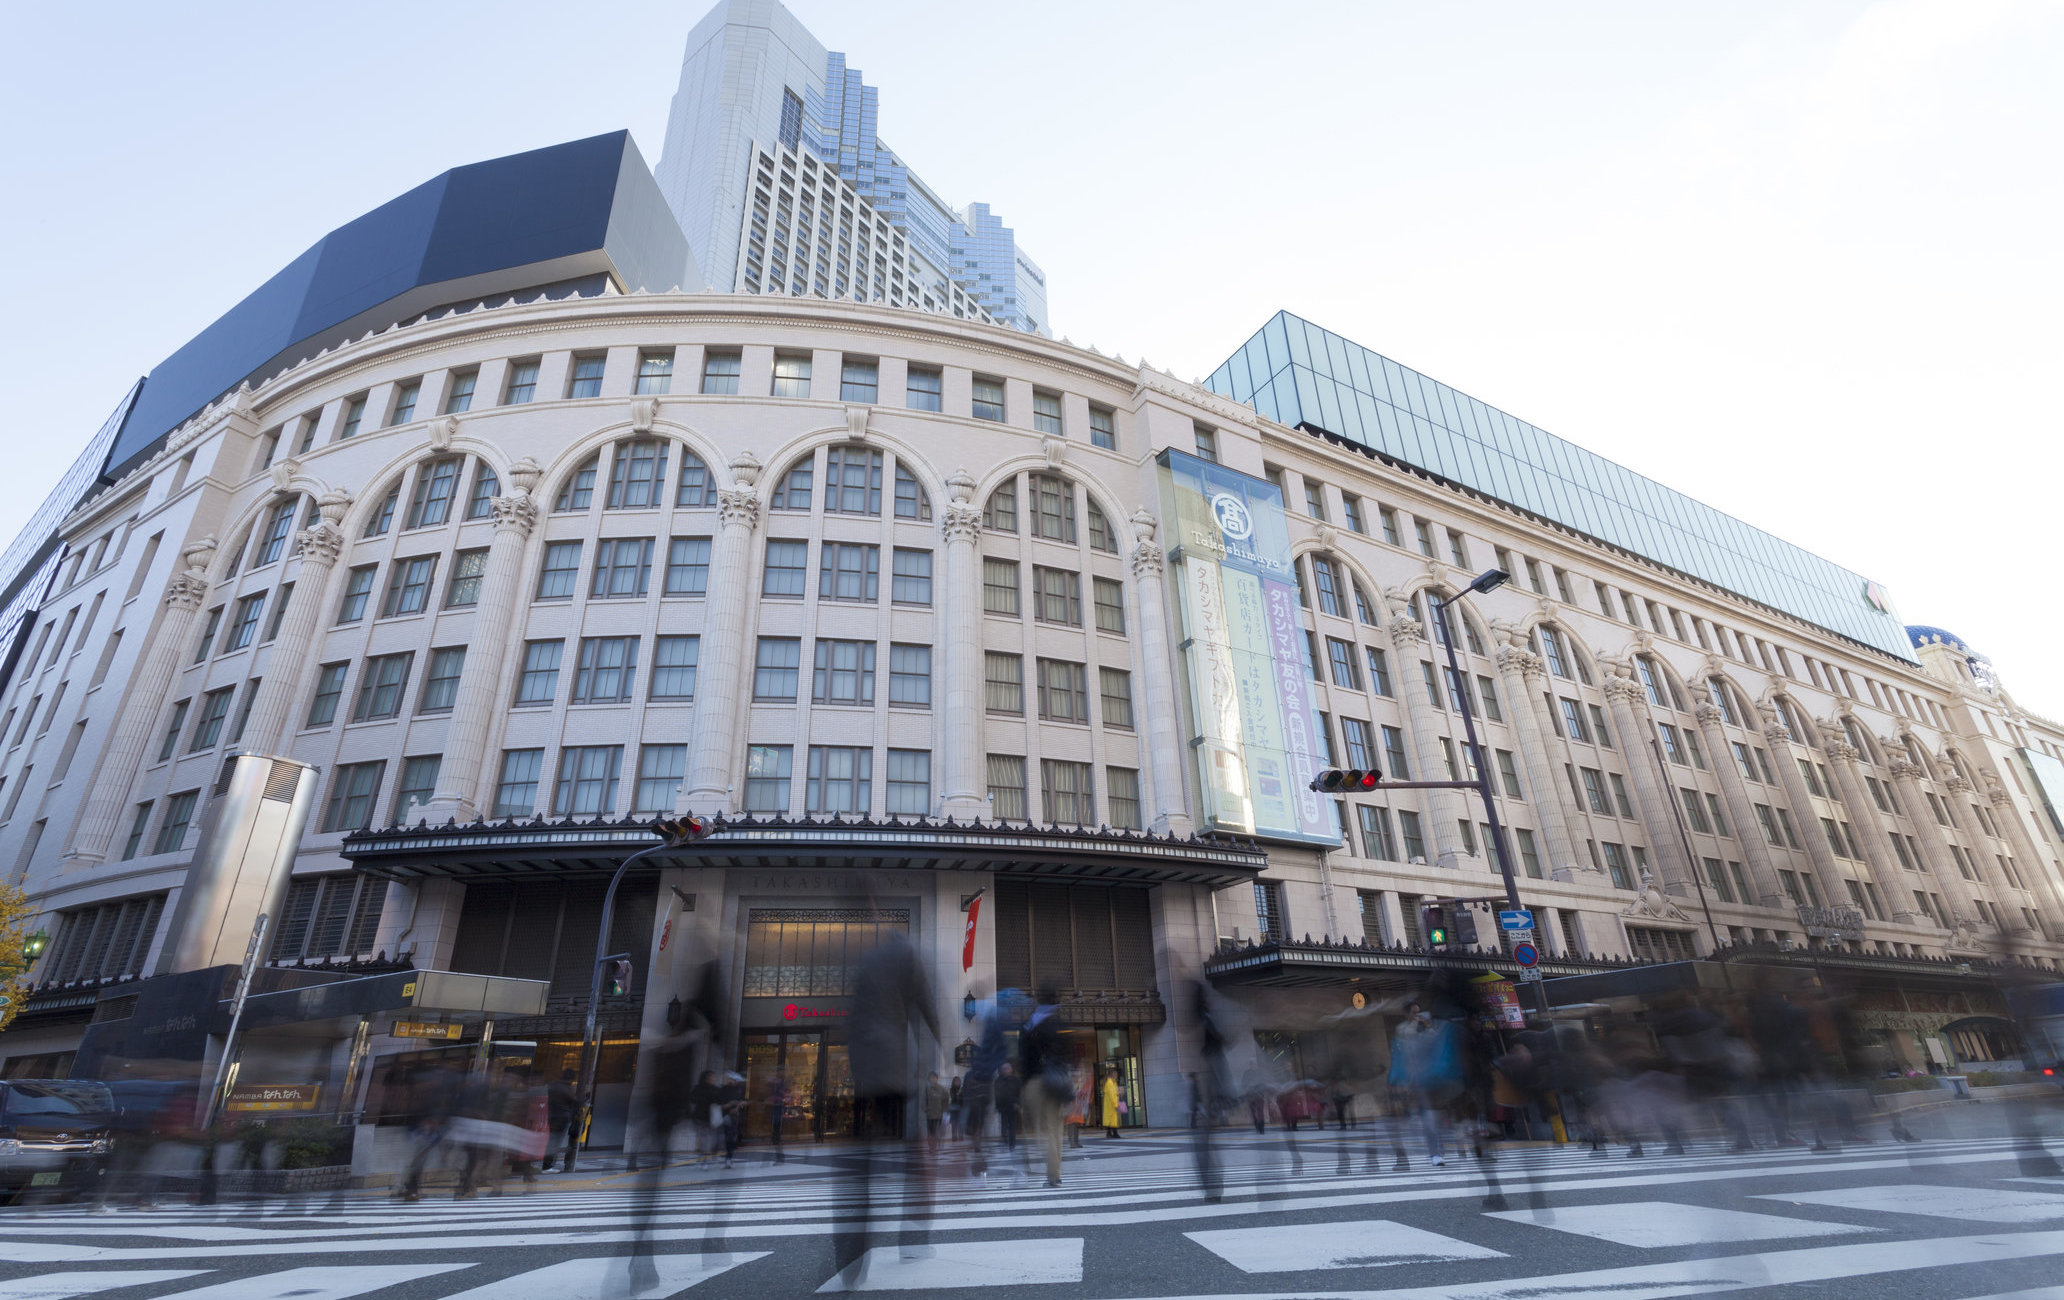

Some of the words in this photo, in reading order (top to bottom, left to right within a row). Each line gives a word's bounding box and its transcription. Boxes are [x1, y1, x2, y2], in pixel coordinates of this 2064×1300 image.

[1191, 530, 1279, 569] Takashimaya
[1270, 589, 1301, 710] タカシマヤ友の会
[800, 1007, 849, 1018] Takashim
[232, 1092, 262, 1100] NAMBA
[263, 1089, 302, 1100] なんなん
